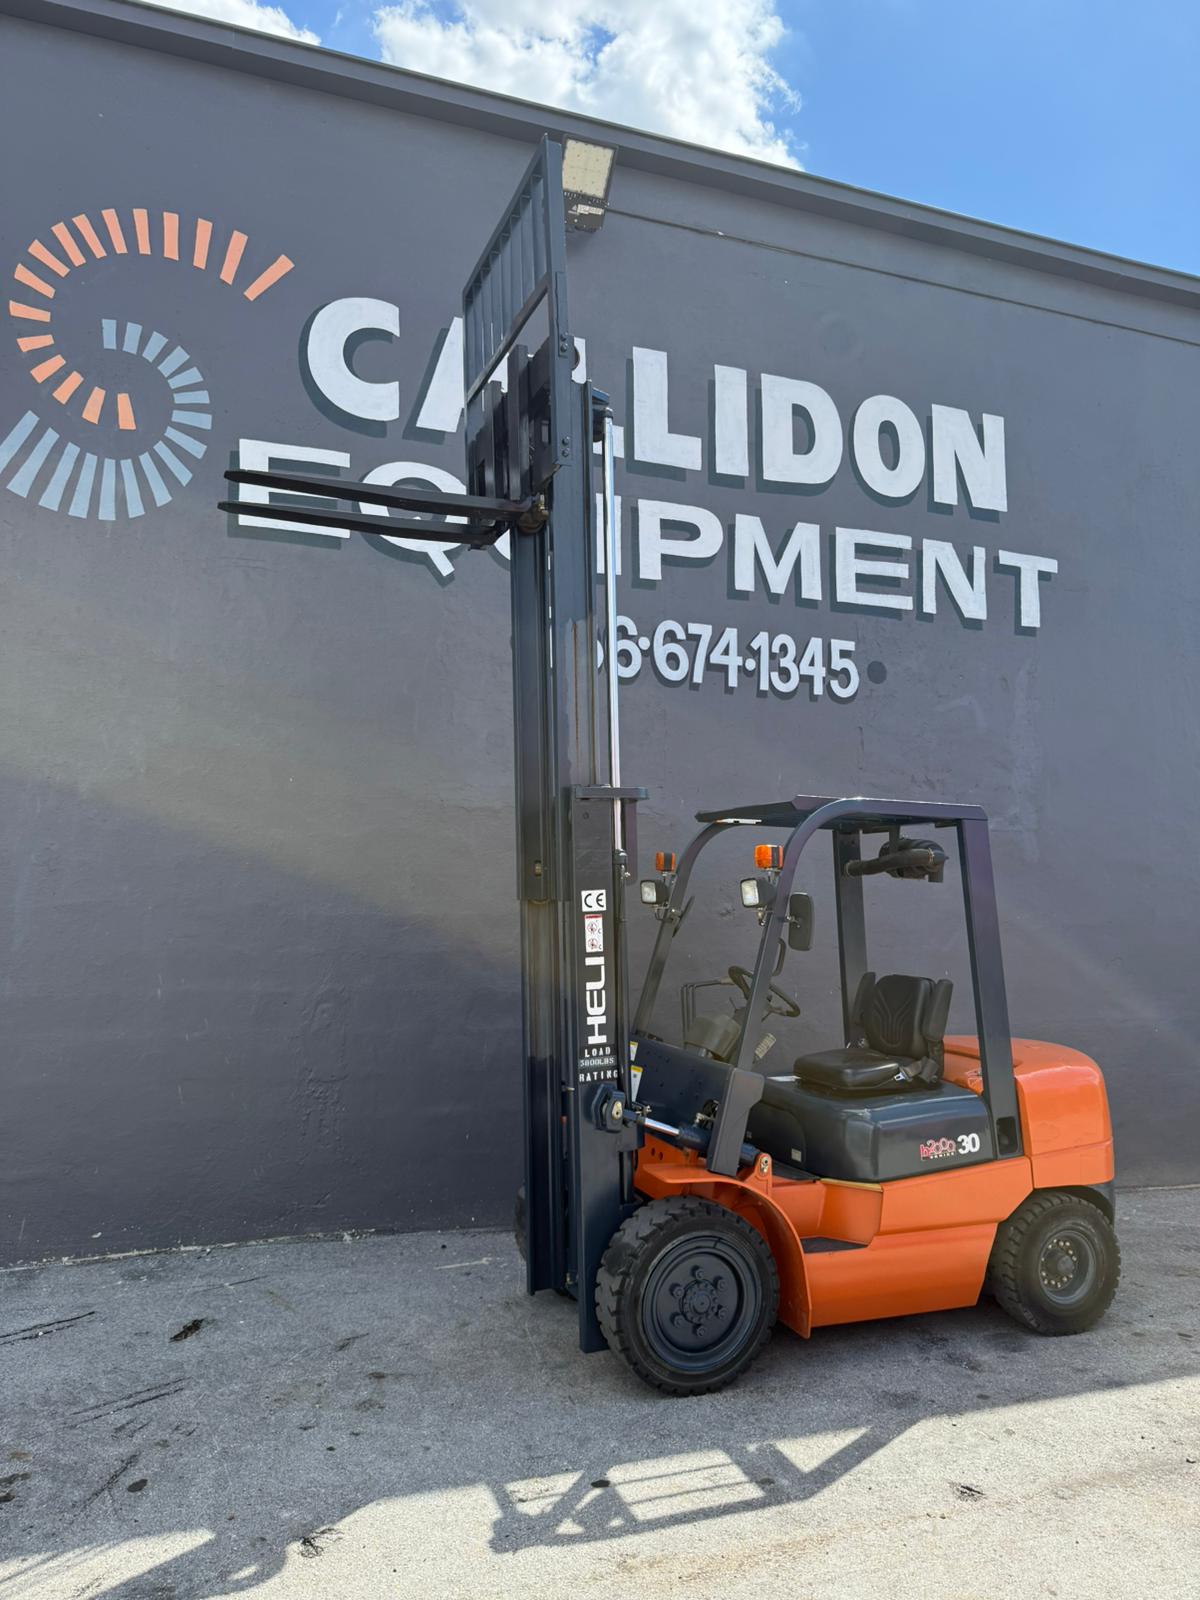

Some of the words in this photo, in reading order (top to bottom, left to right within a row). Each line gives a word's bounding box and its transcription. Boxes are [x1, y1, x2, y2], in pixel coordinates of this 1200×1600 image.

[239, 439, 1058, 628] EQIPMENT
[585, 956, 607, 1045] HELI
[584, 1046, 611, 1058] LOAD
[579, 1069, 618, 1082] RATING
[957, 1133, 980, 1154] 30
